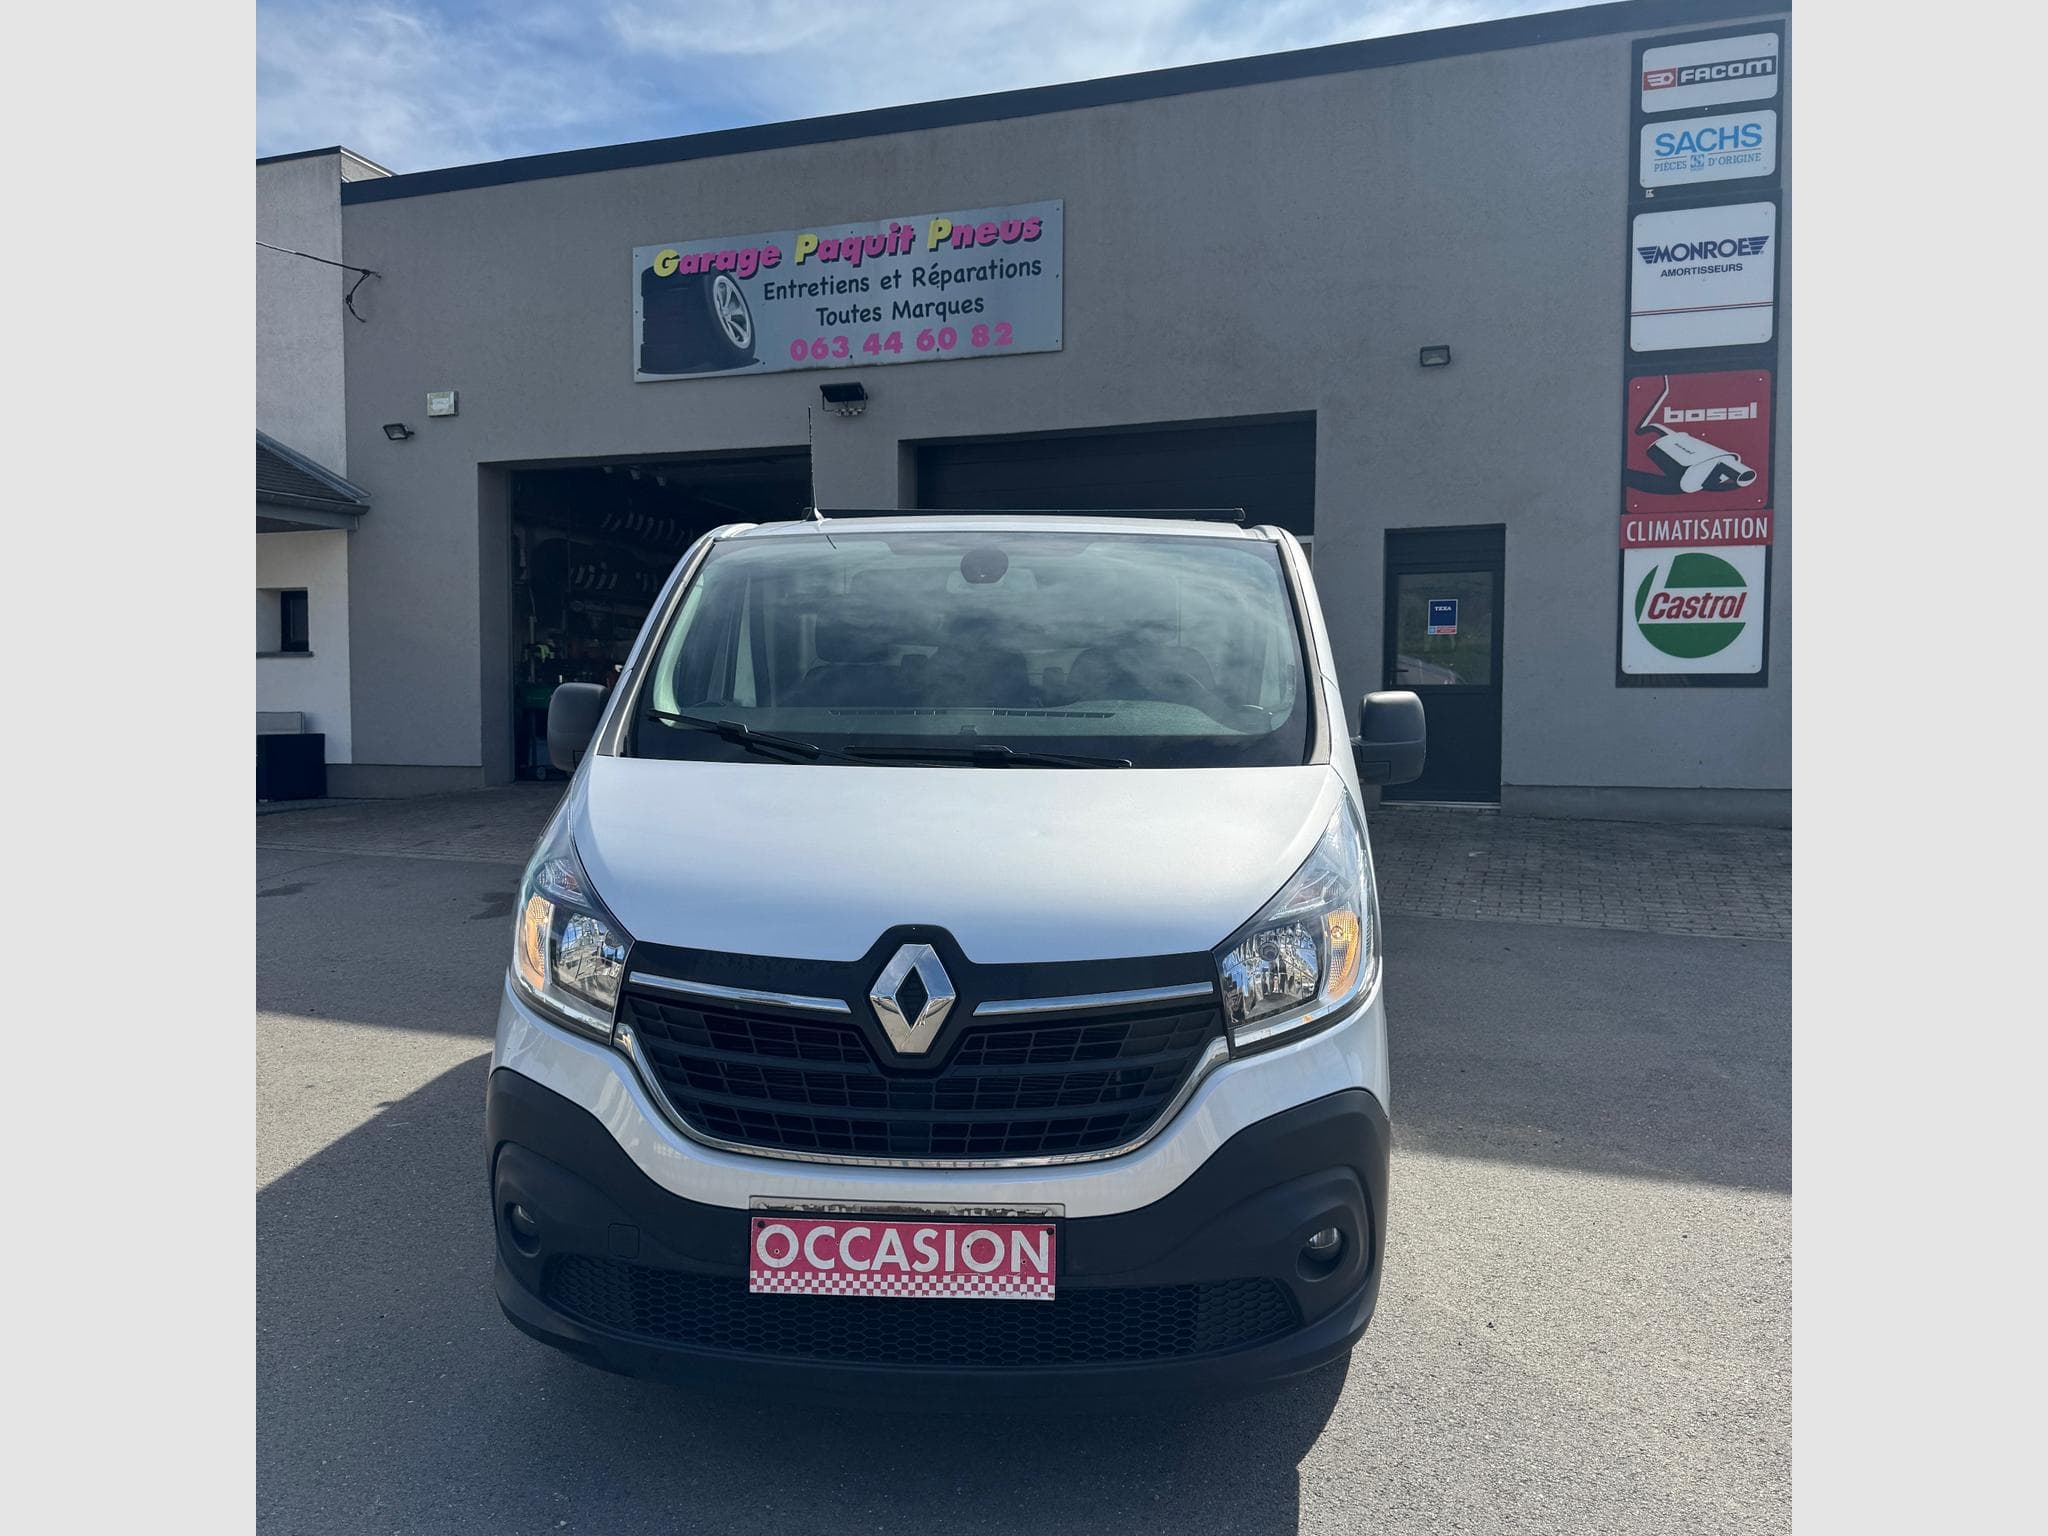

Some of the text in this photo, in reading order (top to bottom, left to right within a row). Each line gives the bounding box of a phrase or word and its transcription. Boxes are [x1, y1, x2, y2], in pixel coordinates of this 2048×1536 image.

[1680, 59, 1772, 83] FACOM
[1655, 123, 1762, 156] SACHS
[1708, 152, 1761, 167] D'ORIGINE
[653, 215, 1042, 279] Garage Paquit Pneus
[1653, 237, 1749, 264] MONROE
[763, 258, 1042, 301] Entretiens et Réparations
[1660, 263, 1743, 277] AMORTISSEURS
[816, 295, 985, 327] Toutes Marques
[790, 322, 1014, 362] 063 44 60 82
[1663, 402, 1758, 423] bosal
[1626, 517, 1768, 542] CLIMATISATION
[1647, 591, 1748, 621] Castrol
[756, 1224, 1050, 1273] OCCASION
